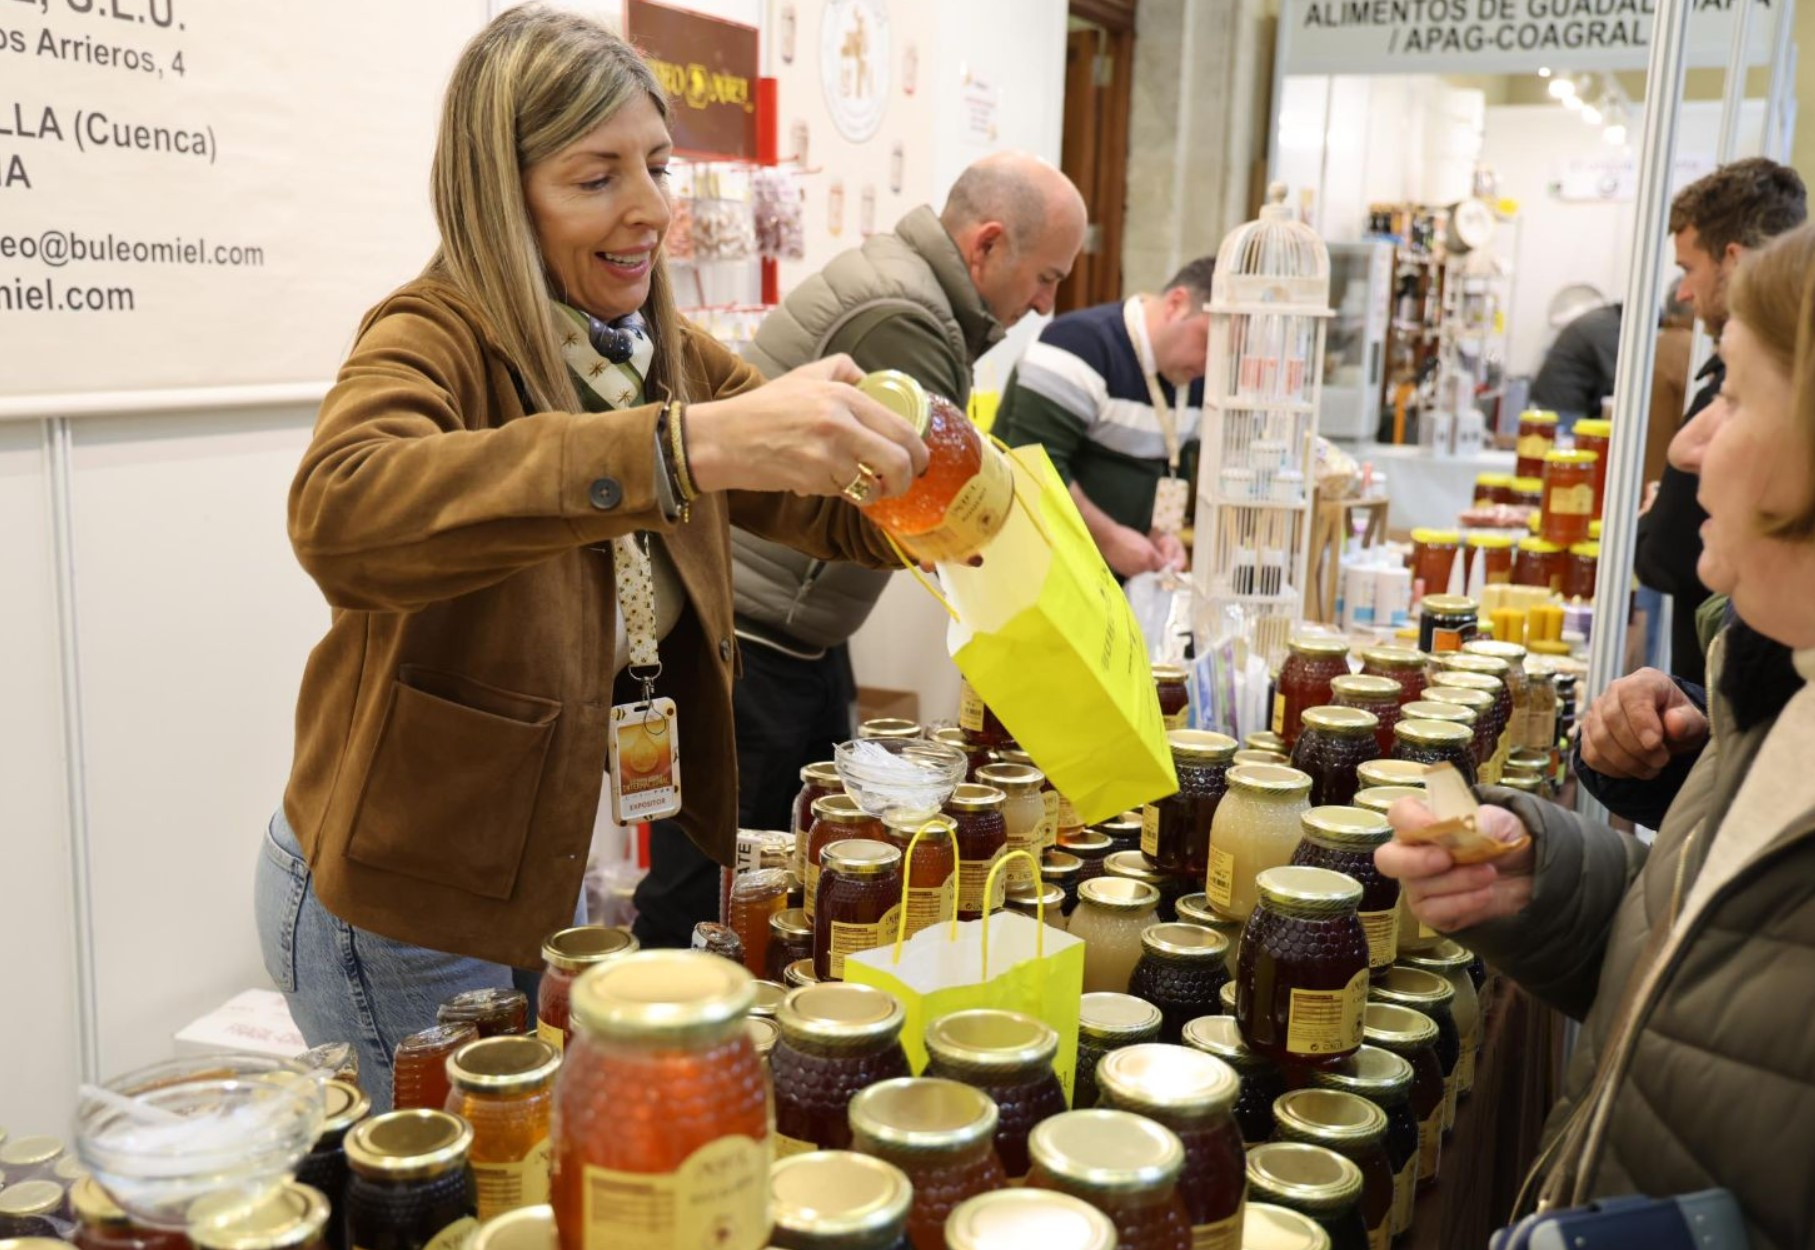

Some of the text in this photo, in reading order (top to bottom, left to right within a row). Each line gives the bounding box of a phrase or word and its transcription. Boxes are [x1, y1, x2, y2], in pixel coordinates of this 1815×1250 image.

[1302, 0, 1466, 27] ALIMENTOS
[1477, 0, 1515, 21] DE
[36, 28, 163, 79] Arrieros,
[171, 50, 186, 77] 4
[1402, 20, 1648, 54] APAG-COAGRAL
[74, 110, 216, 164] (Cuenca)
[0, 230, 264, 267] eo@buleomiel.com
